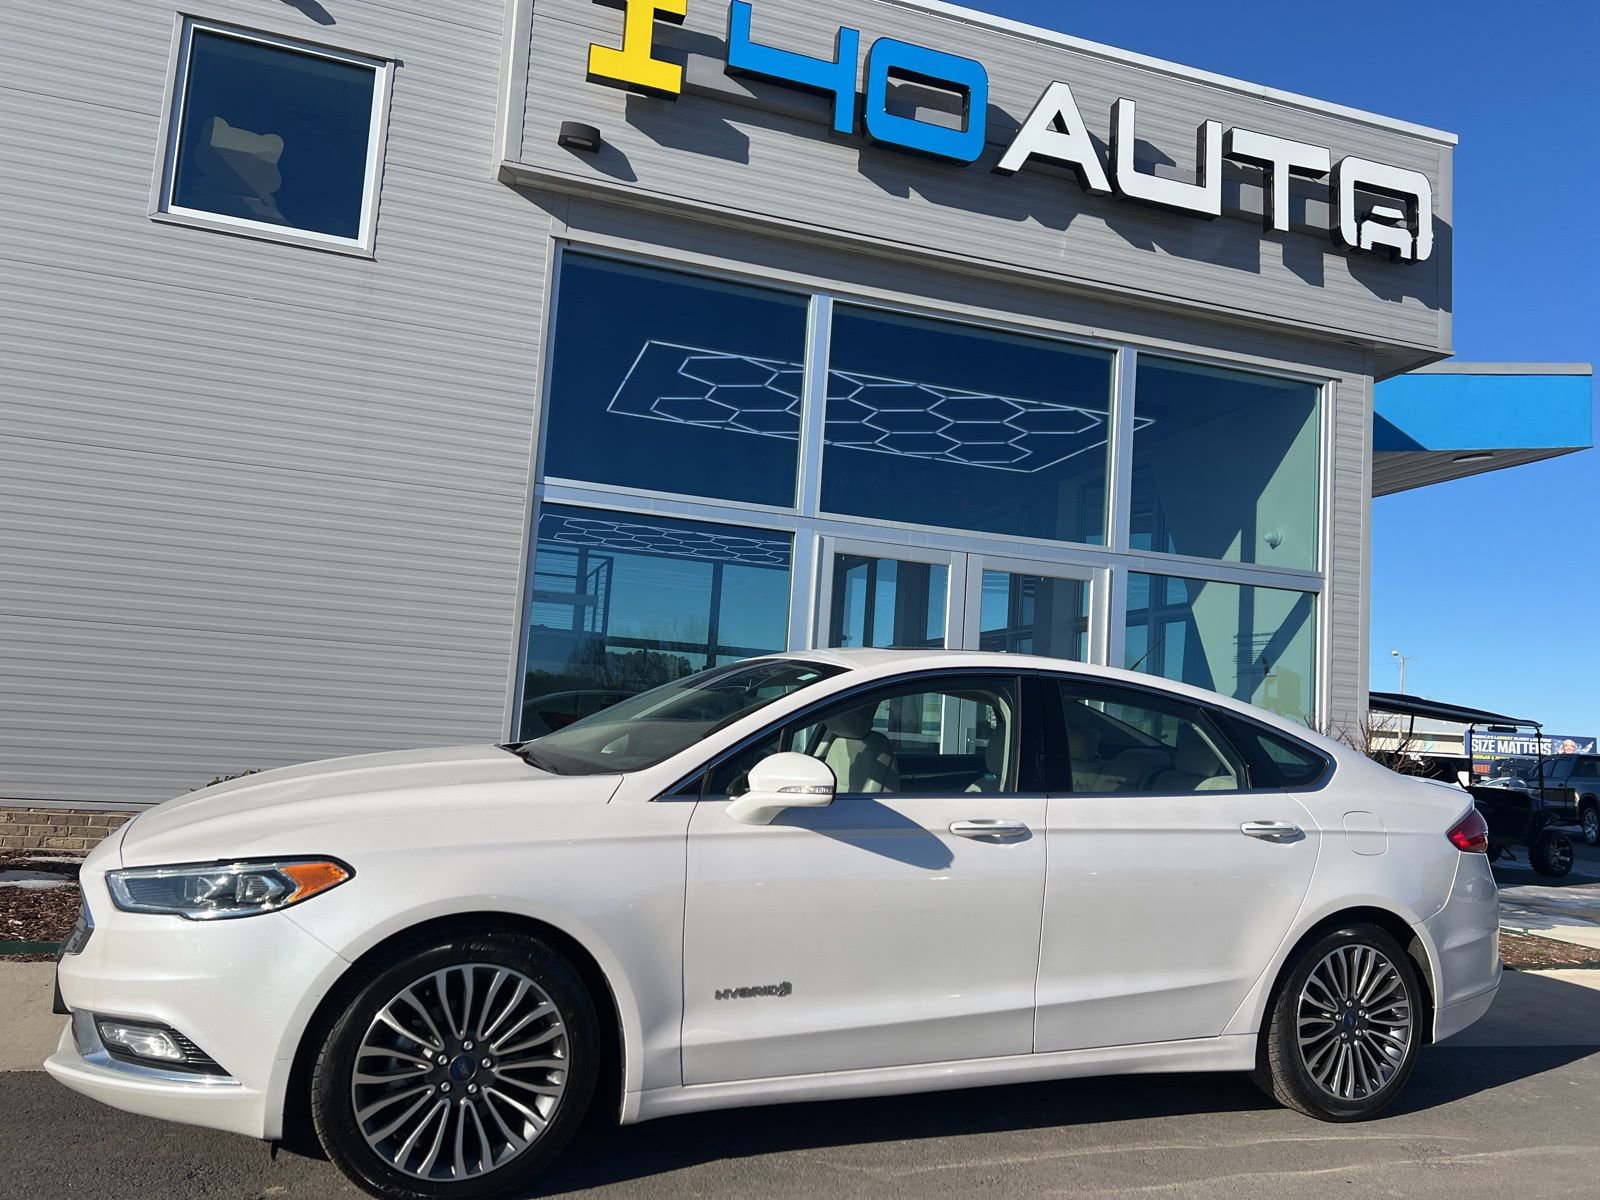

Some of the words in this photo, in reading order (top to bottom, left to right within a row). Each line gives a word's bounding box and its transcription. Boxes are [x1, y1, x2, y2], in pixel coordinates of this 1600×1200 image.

[587, 0, 687, 95] I
[725, 0, 989, 164] 40
[999, 80, 1435, 263] AUTO
[1471, 738, 1496, 753] SIZE
[1497, 740, 1552, 755] MATTERS
[715, 985, 778, 1000] HYBRID
